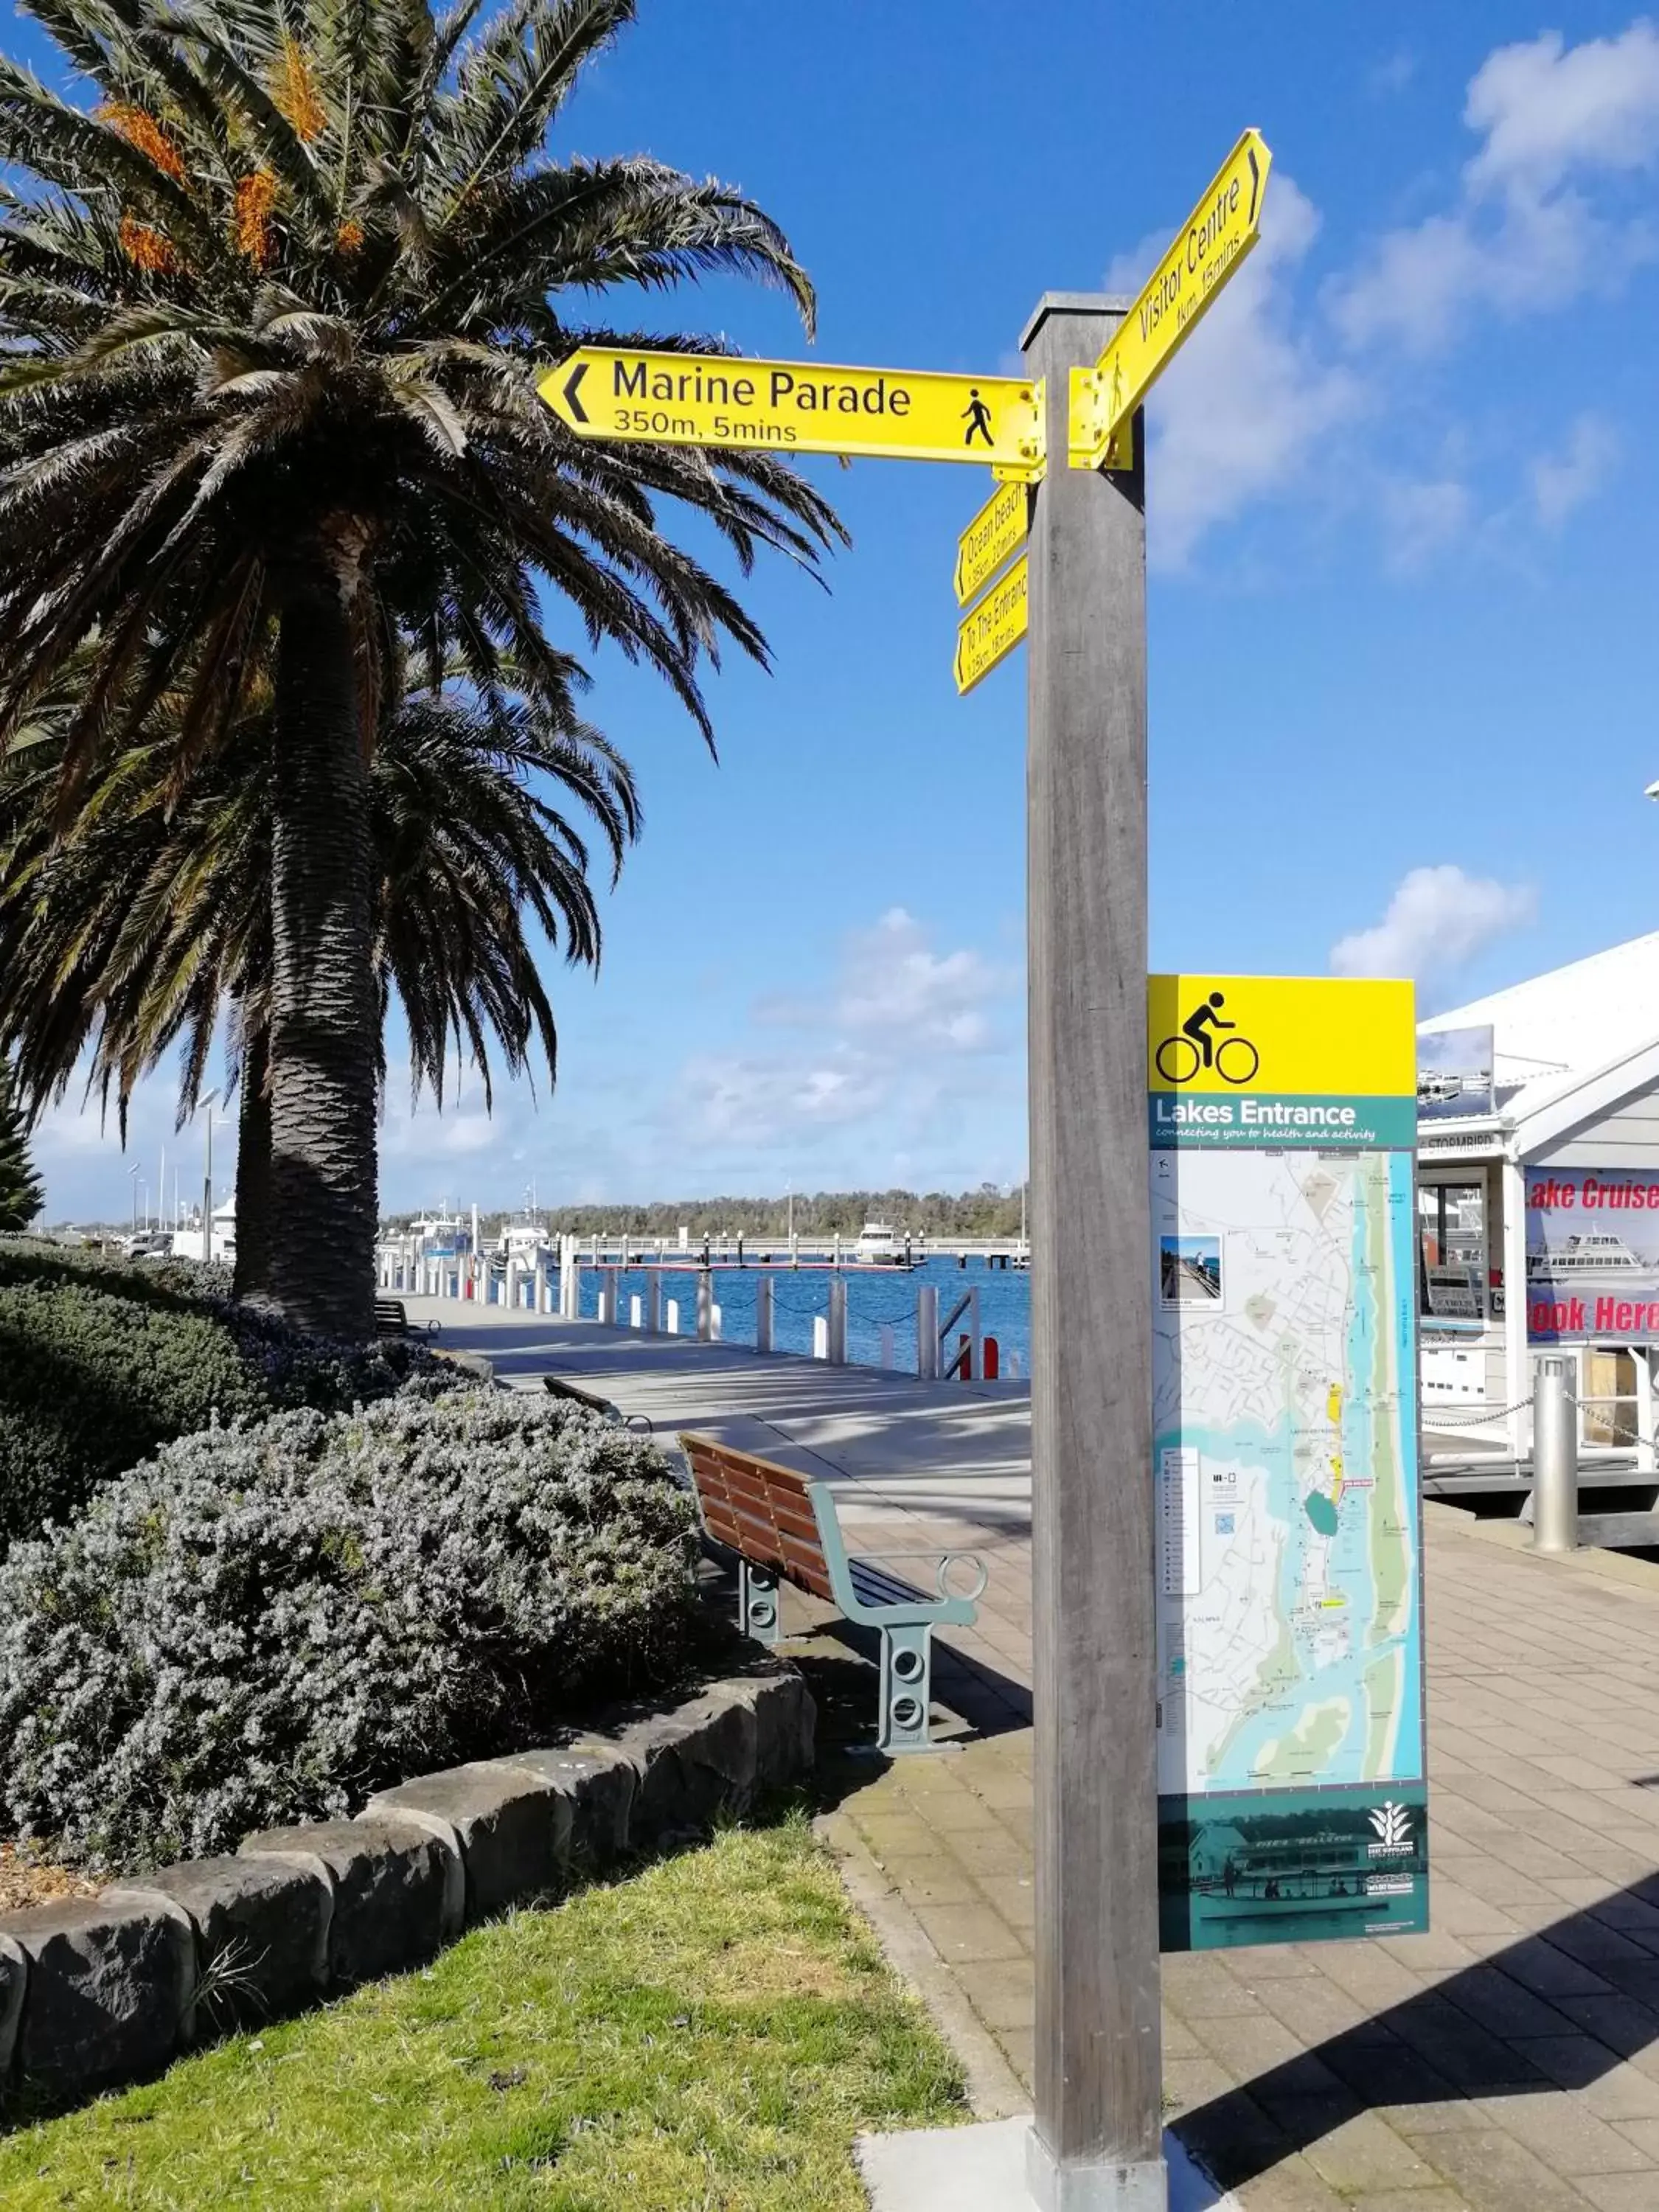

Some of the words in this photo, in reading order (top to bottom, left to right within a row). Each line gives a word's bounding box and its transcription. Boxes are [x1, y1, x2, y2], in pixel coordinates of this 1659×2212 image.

[1138, 260, 1183, 343] Visitor
[1186, 177, 1240, 274] Centre
[1200, 230, 1240, 296] 15mins
[613, 360, 756, 407] Marine
[770, 371, 911, 416] Parade
[613, 408, 703, 439] 350m,
[713, 415, 798, 442] 5mins
[968, 518, 993, 564] Ocean
[967, 626, 975, 654] To
[977, 612, 992, 643] The
[1157, 1099, 1233, 1124] Lakes
[1240, 1099, 1356, 1125] Entrance
[1156, 1127, 1220, 1140] connecting
[1223, 1129, 1246, 1139] you
[1248, 1127, 1260, 1138] to
[1263, 1126, 1302, 1138] health
[1305, 1128, 1329, 1138] and
[1331, 1127, 1376, 1142] activity
[1428, 1135, 1494, 1155] STORMBIRD
[1527, 1297, 1587, 1333] ook
